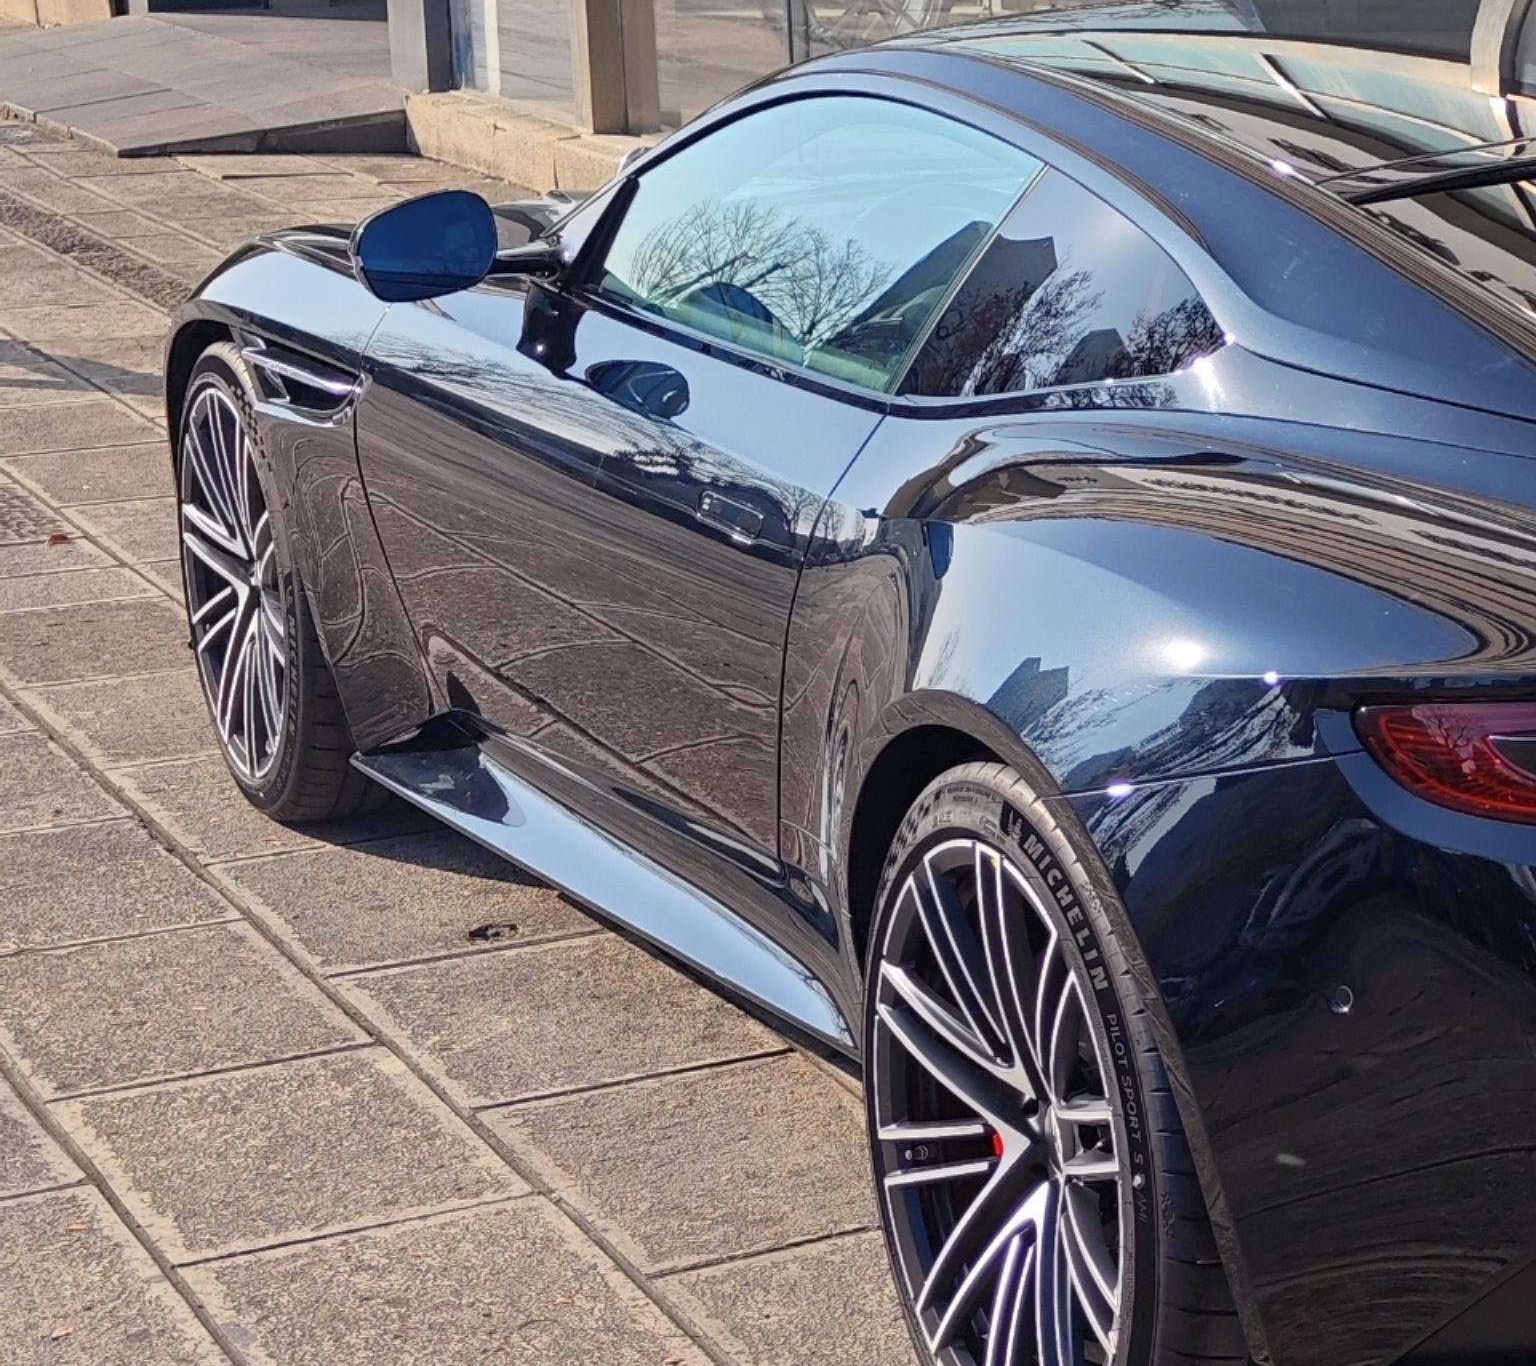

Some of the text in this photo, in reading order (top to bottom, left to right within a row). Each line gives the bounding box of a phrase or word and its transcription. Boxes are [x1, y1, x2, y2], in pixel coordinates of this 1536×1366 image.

[1023, 834, 1109, 990] MICHELIN
[1106, 1012, 1129, 1066] PILOT
[1121, 1073, 1142, 1143] SPORT
[1133, 1154, 1144, 1166] S
